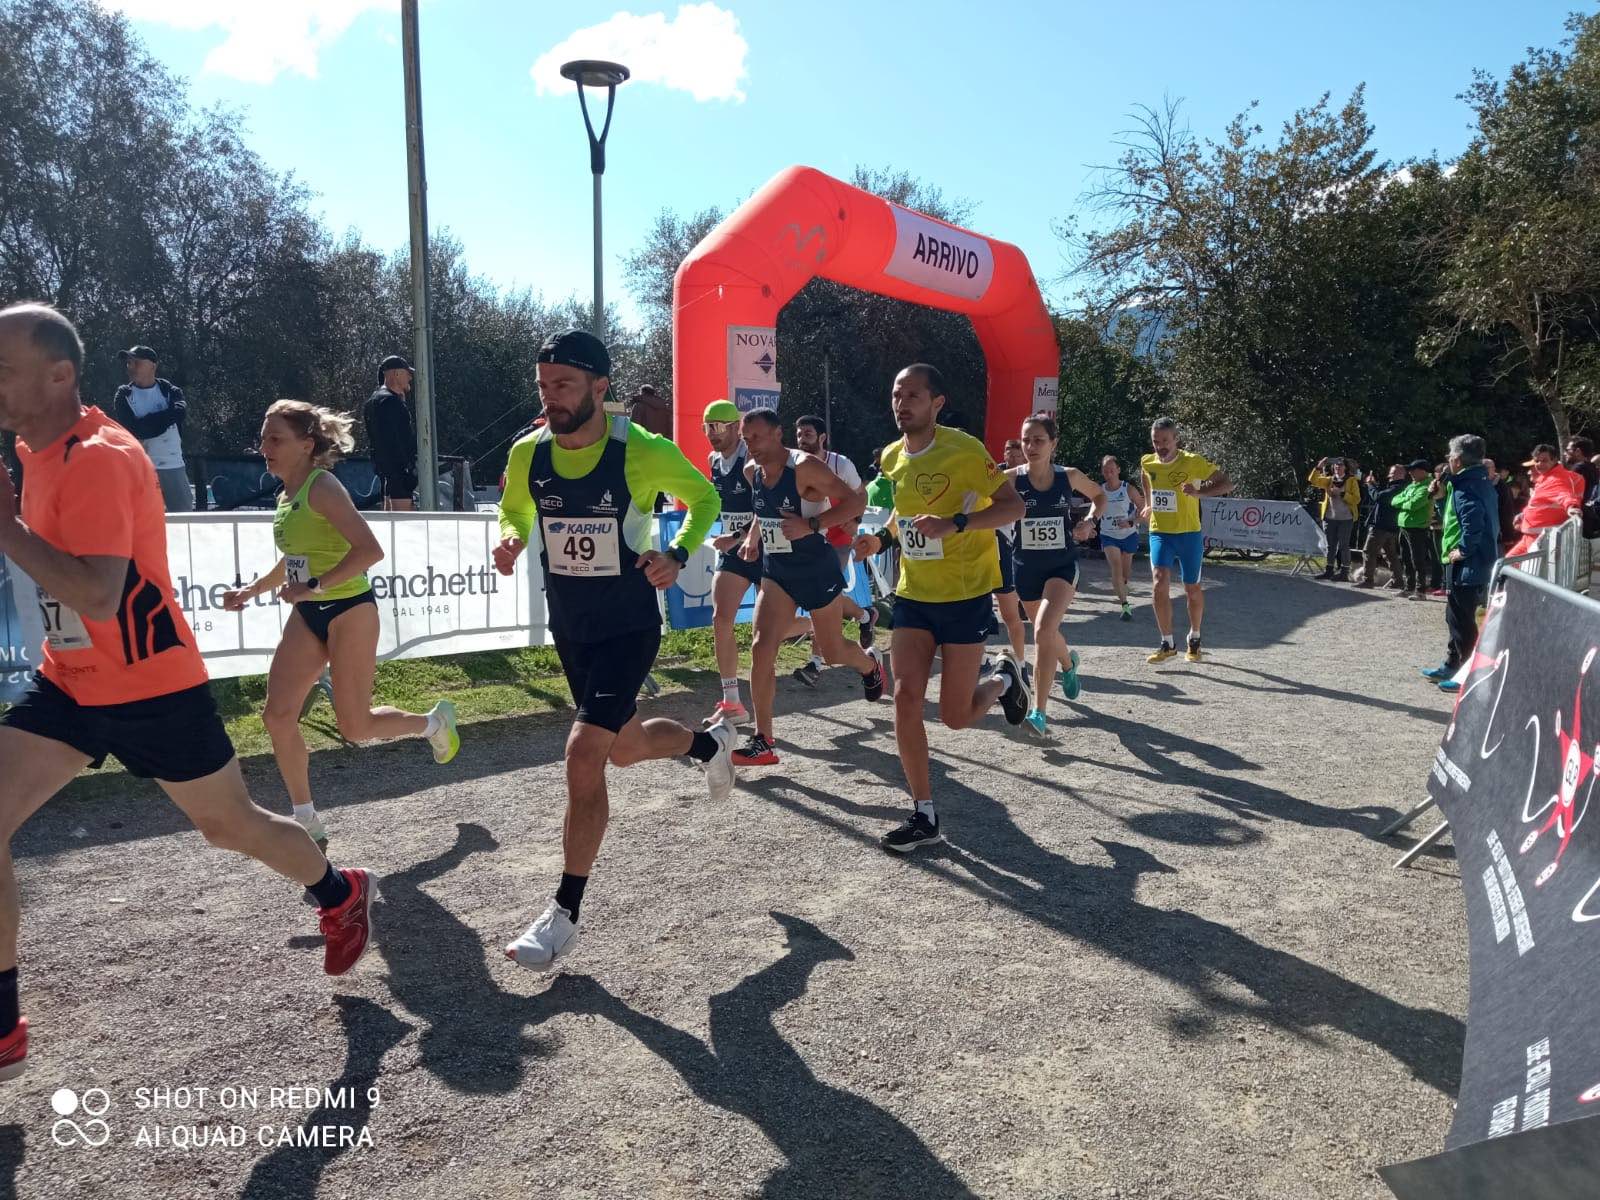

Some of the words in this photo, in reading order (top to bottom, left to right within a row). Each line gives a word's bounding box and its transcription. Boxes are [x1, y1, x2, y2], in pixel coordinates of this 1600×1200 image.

[913, 232, 979, 279] ARRIVO
[1155, 497, 1168, 506] 99
[567, 523, 612, 534] KARHU
[1029, 527, 1057, 541] 153
[906, 530, 926, 549] 30
[563, 536, 596, 561] 49
[371, 564, 499, 600] enchetti
[392, 606, 415, 617] DAL
[421, 604, 450, 616] 1948
